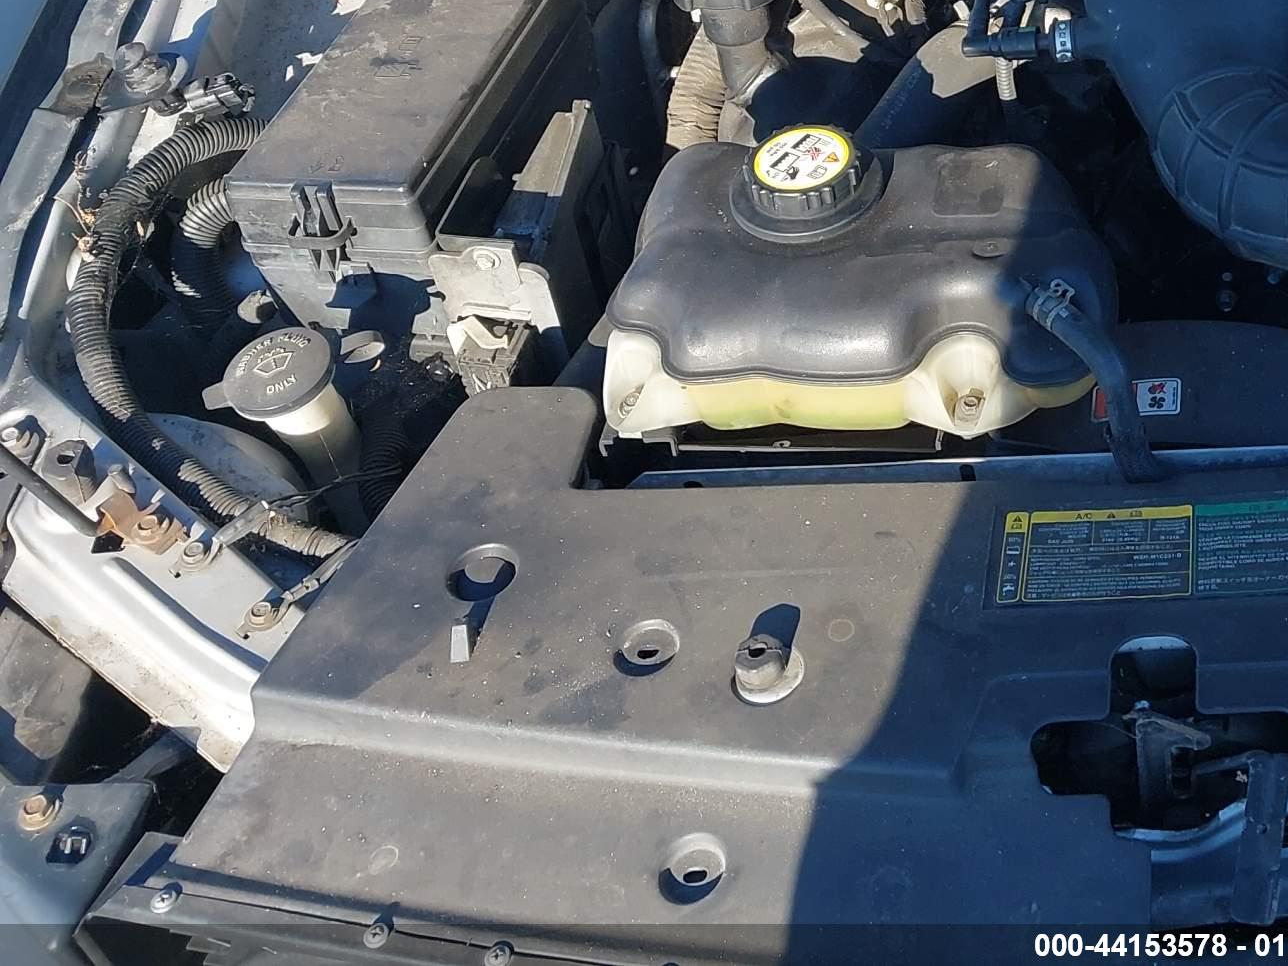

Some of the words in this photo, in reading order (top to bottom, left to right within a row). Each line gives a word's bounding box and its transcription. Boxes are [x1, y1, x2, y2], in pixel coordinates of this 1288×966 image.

[277, 333, 310, 348] FLUID
[266, 373, 298, 394] ONLY
[1075, 512, 1093, 520] A/C
